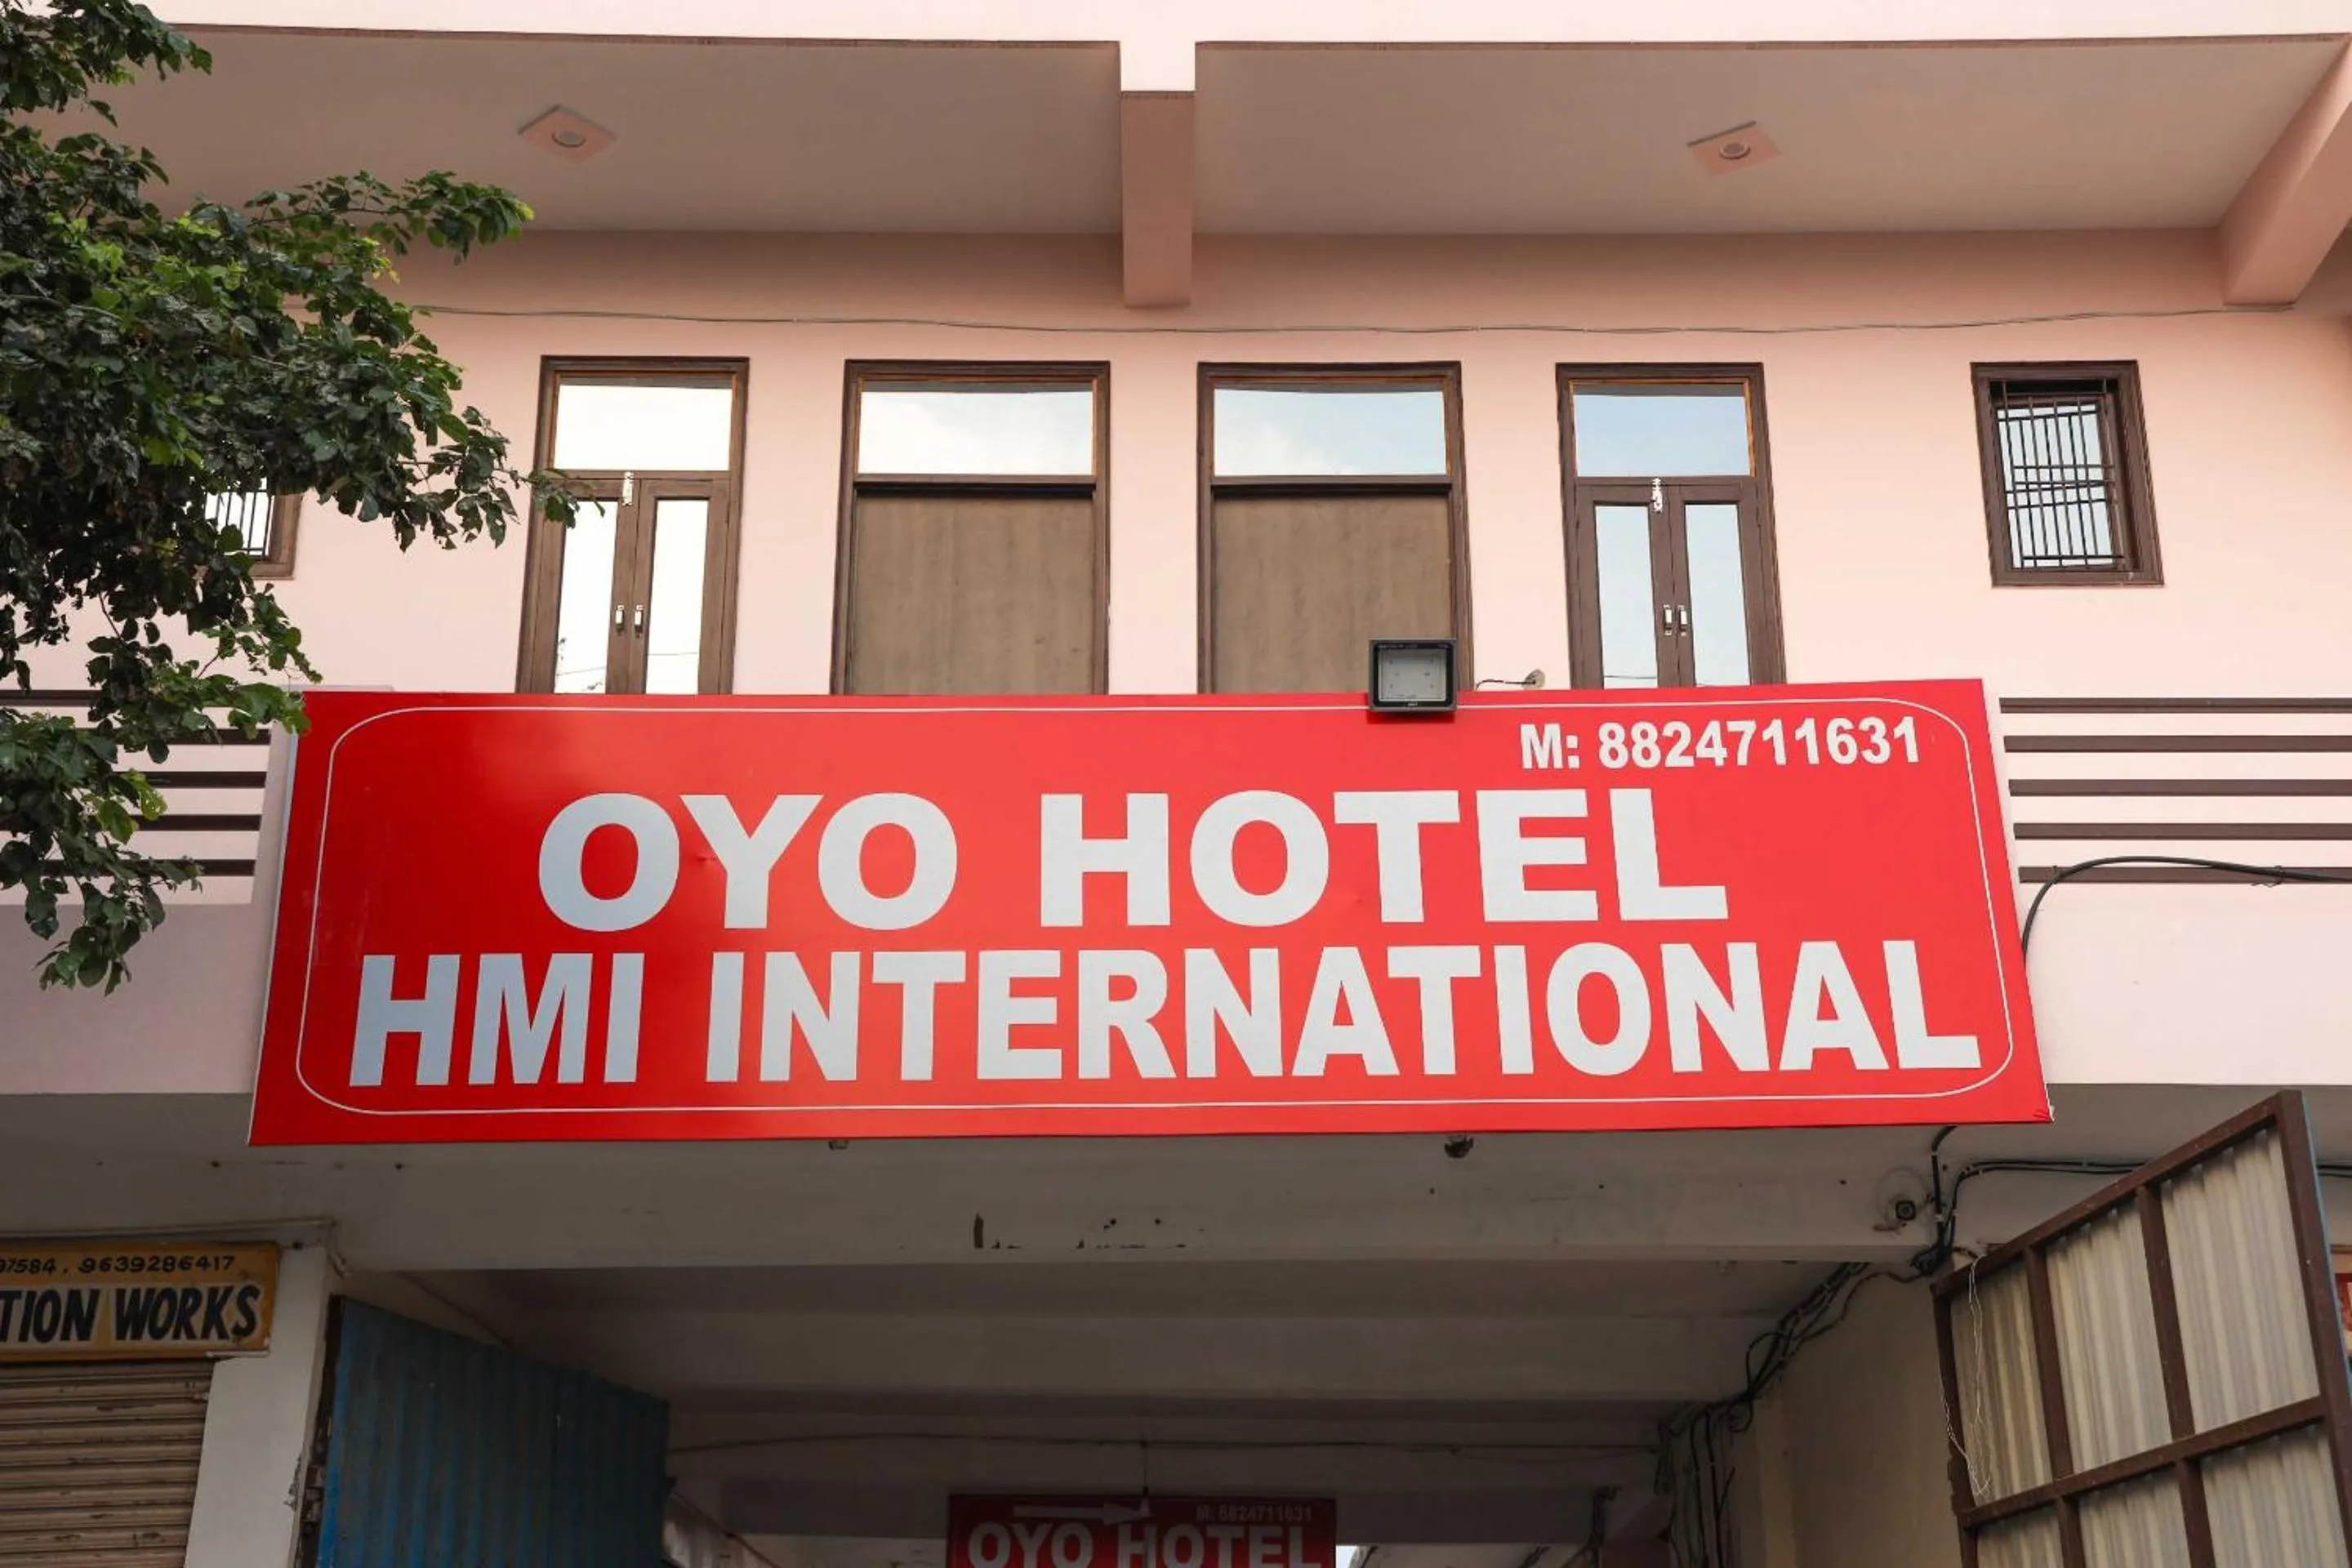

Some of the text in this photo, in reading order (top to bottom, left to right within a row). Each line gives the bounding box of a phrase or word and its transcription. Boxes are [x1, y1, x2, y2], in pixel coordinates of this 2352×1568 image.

[1521, 715, 1919, 769] M: 8824711631
[540, 788, 1730, 931] OYO HOTEL
[350, 939, 1982, 1085] HMI INTERNATIONAL
[78, 1255, 235, 1274] 9639286417
[0, 1284, 261, 1343] TION WORKS
[968, 1522, 1322, 1568] OYO HOTEL
